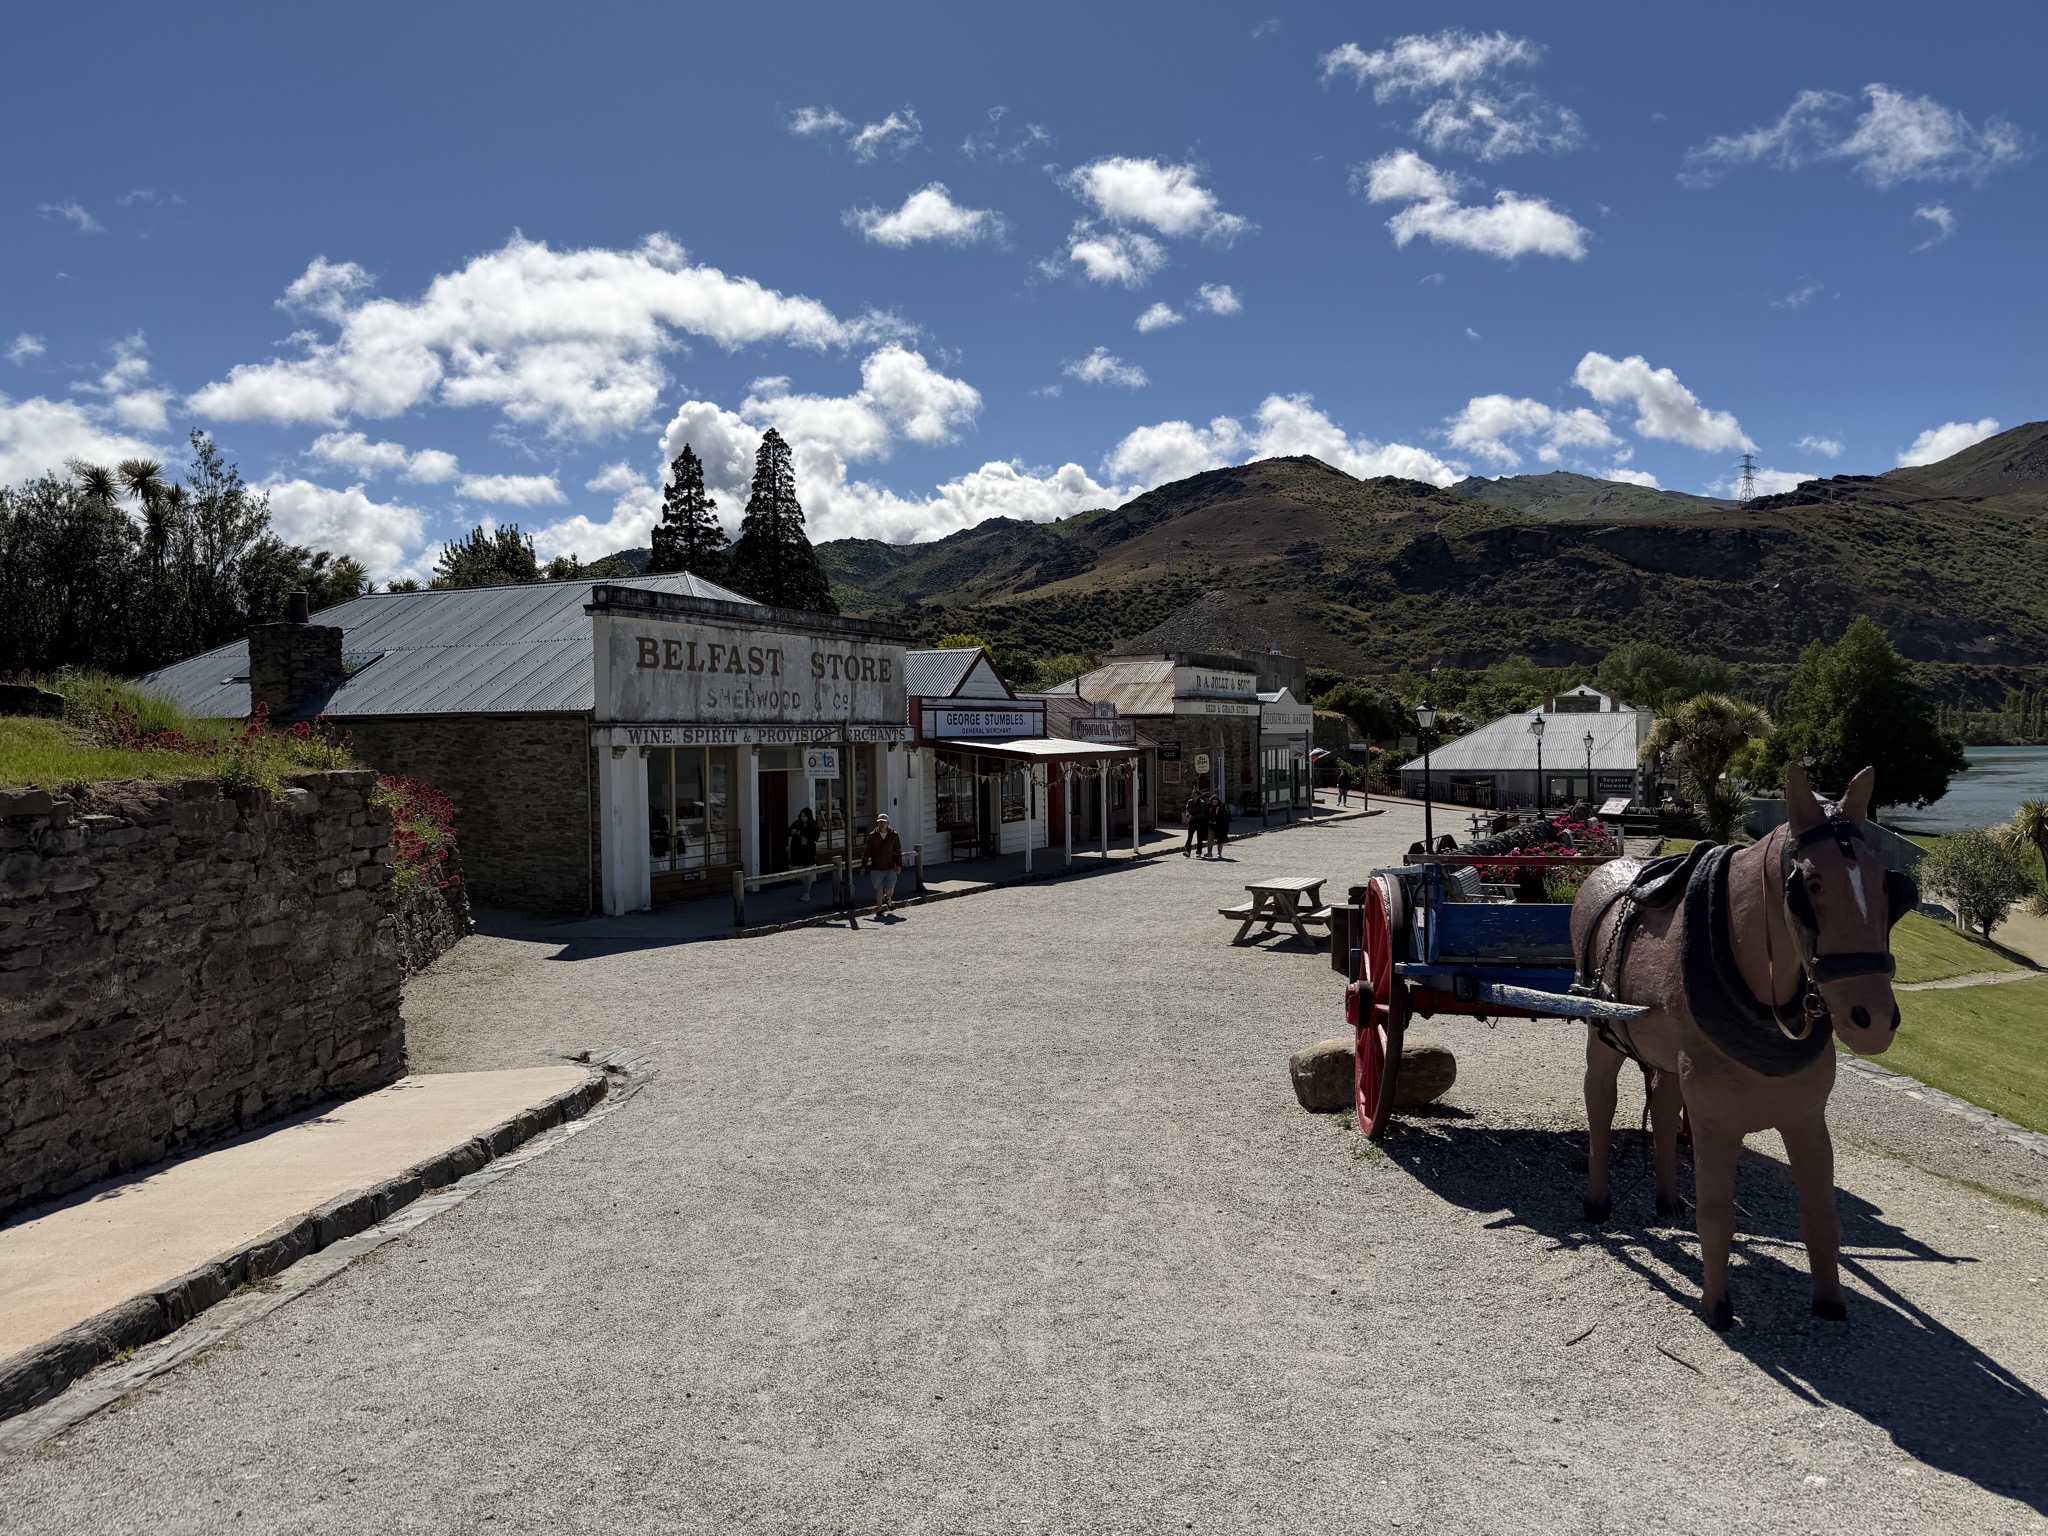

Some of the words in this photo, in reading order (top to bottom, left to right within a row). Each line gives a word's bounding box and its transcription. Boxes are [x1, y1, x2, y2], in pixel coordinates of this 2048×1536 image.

[636, 637, 782, 676] BELFAST
[810, 651, 892, 683] STORE
[1211, 677, 1229, 690] JOLLY
[1231, 678, 1235, 690] &
[706, 687, 801, 710] SHERWOOD
[813, 691, 822, 711] &
[1205, 704, 1216, 713] SEED
[1222, 705, 1235, 714] GRAIN
[1236, 706, 1249, 715] STORE
[946, 713, 980, 726] GEORGE
[984, 714, 1025, 726] STUMBLES.
[683, 729, 738, 744] SPIRIT
[743, 733, 752, 743] &
[758, 729, 832, 743] PROVISION
[961, 727, 984, 735] GENERAL
[1077, 720, 1110, 739] CROMWELL
